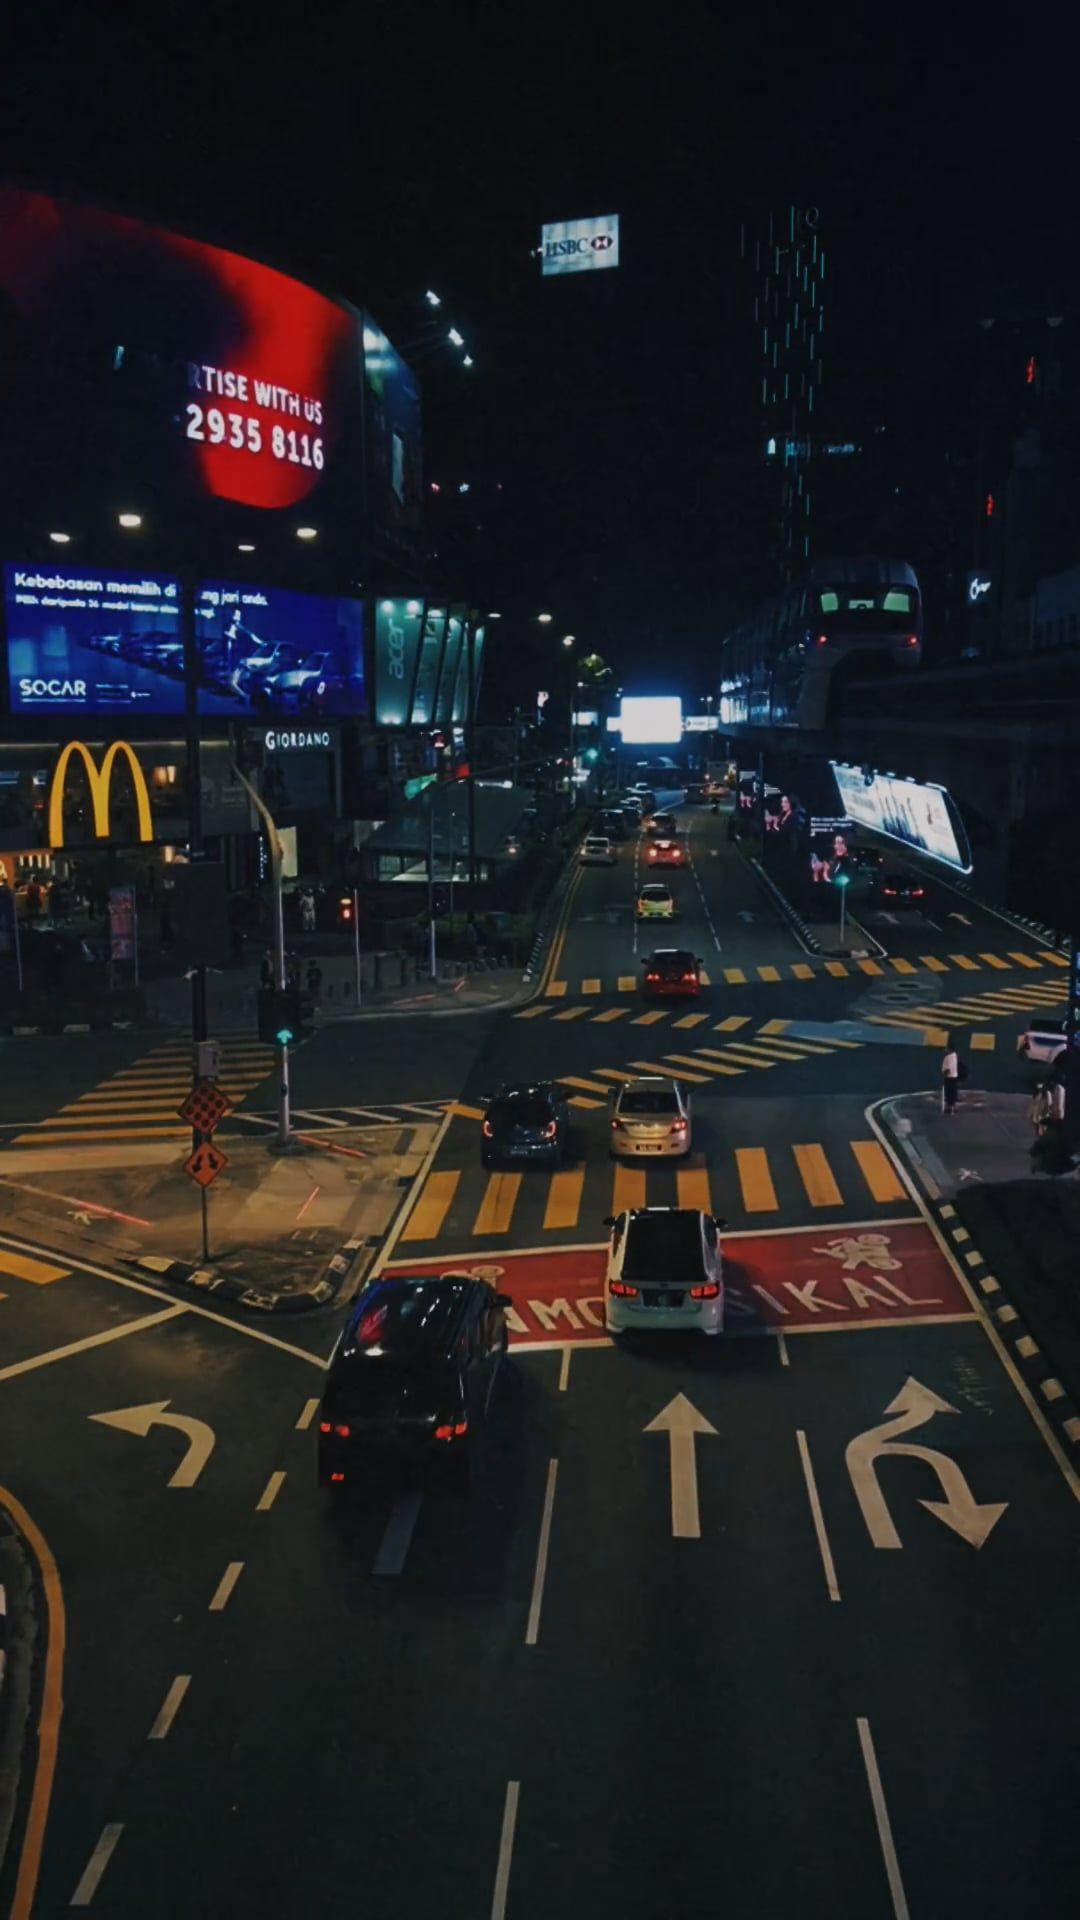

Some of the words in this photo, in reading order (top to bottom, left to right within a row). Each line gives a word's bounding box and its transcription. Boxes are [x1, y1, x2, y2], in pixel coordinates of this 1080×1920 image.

[545, 237, 589, 257] HSBC
[253, 379, 301, 417] WITH
[304, 396, 323, 426] US
[186, 403, 263, 453] 2935
[271, 424, 325, 471] 8116
[14, 572, 103, 592] Kebebasan
[107, 580, 161, 597] memilih
[387, 617, 405, 680] acer
[19, 678, 87, 697] SOCAR
[265, 731, 330, 751] GIORDANO
